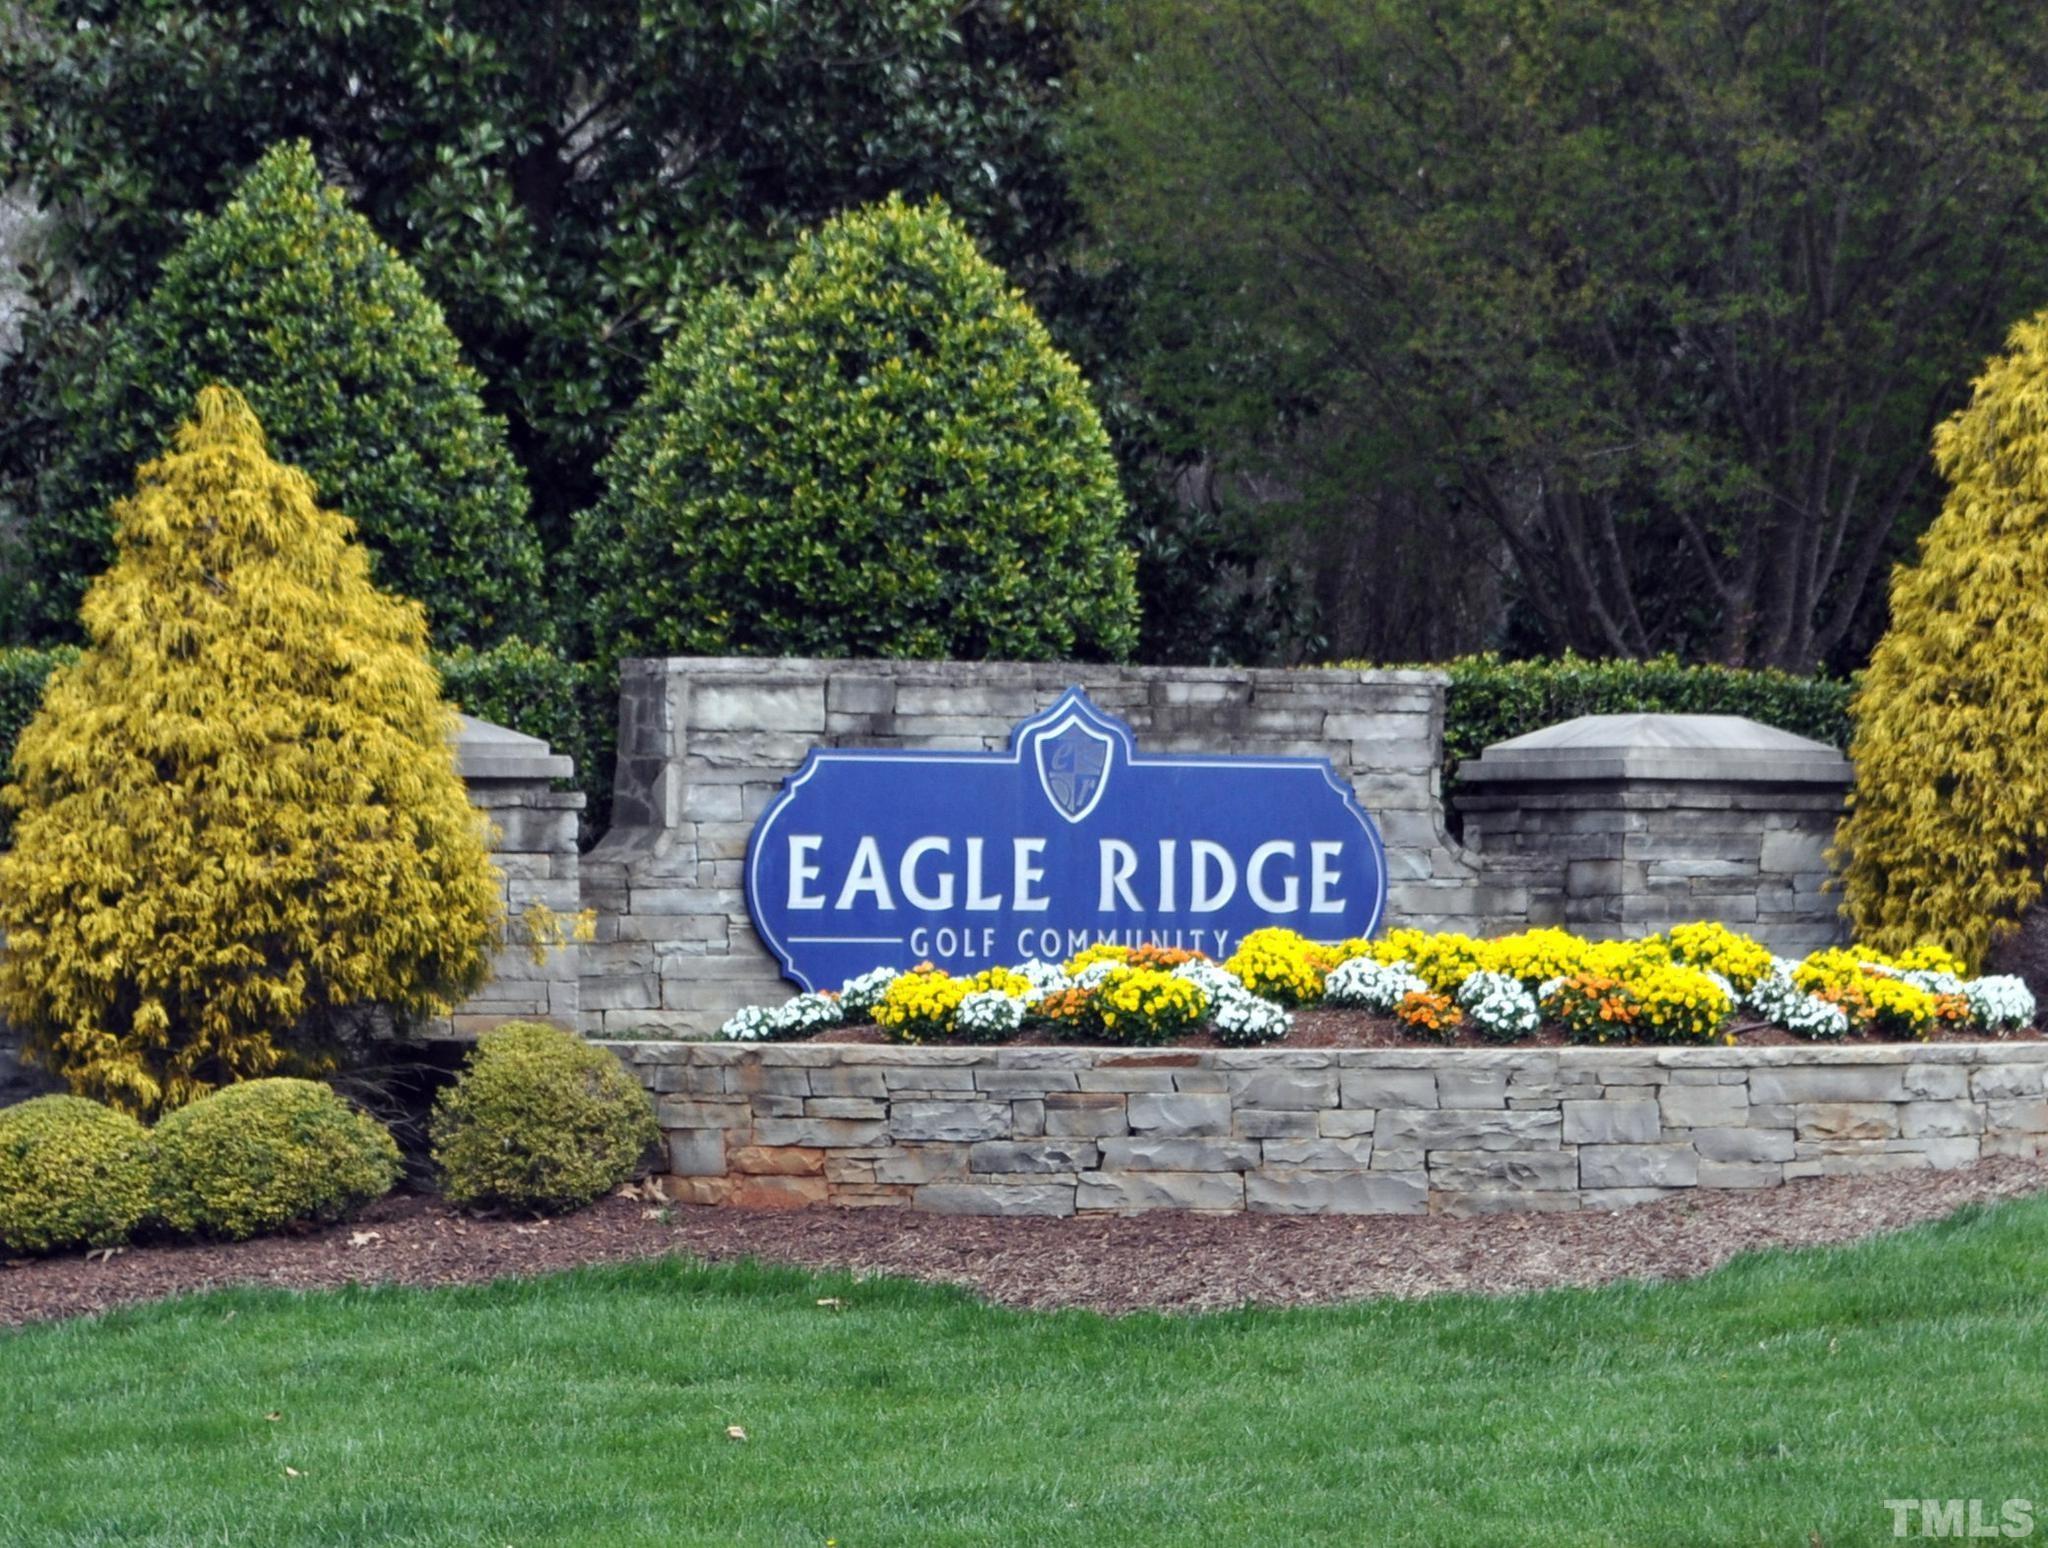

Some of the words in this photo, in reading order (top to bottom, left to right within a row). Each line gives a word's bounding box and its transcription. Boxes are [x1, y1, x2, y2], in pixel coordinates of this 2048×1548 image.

[787, 835, 1050, 911] EAGLE
[1098, 838, 1347, 914] RIDGE
[910, 928, 995, 957] GOLF
